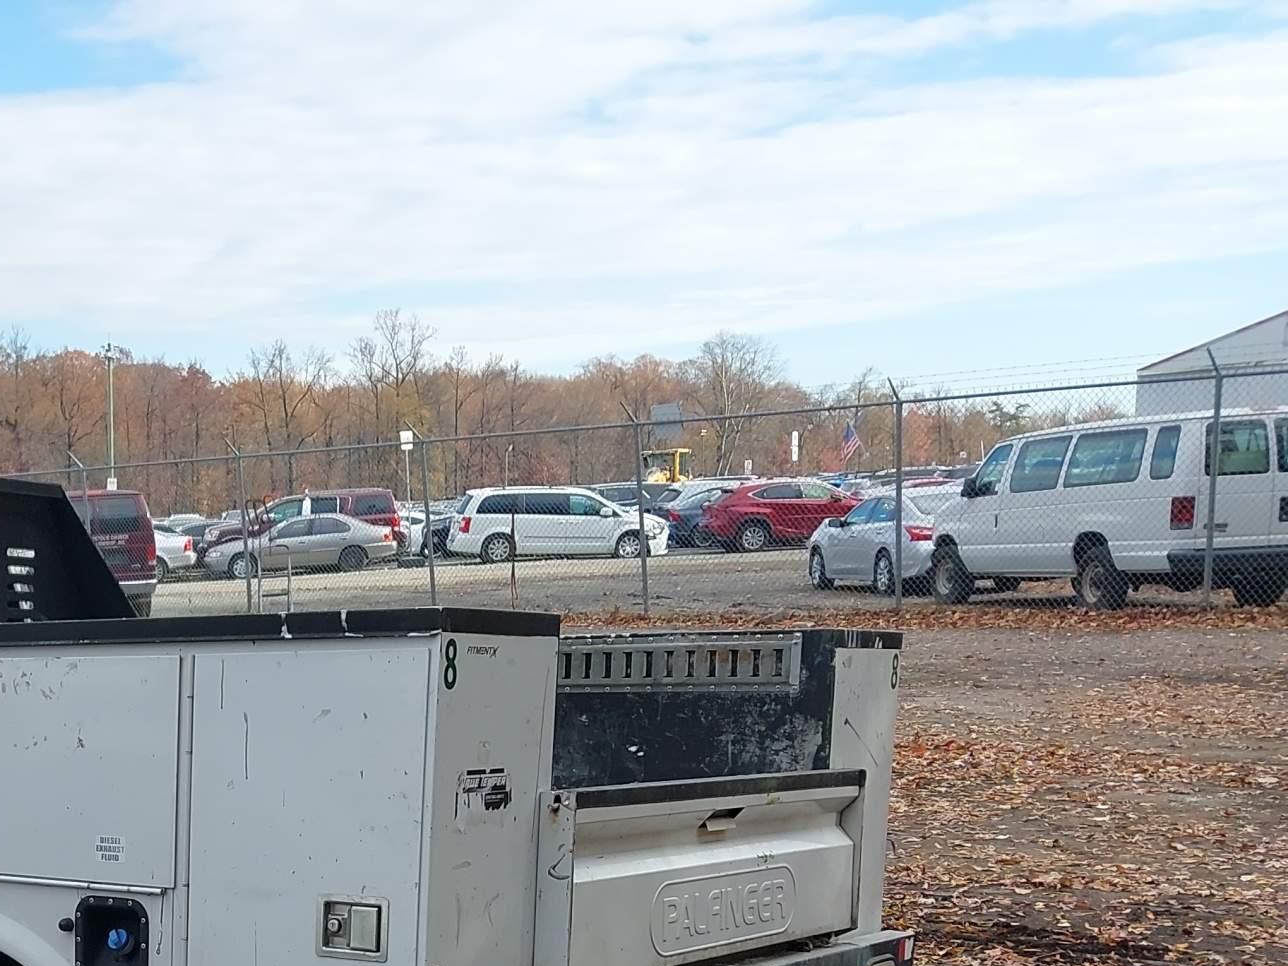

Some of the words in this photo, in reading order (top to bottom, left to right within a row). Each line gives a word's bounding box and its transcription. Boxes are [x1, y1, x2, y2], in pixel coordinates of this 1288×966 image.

[444, 638, 457, 690] 8
[891, 653, 899, 690] 8
[96, 844, 125, 854] EXHAUST
[663, 879, 787, 943] PALFINGER
